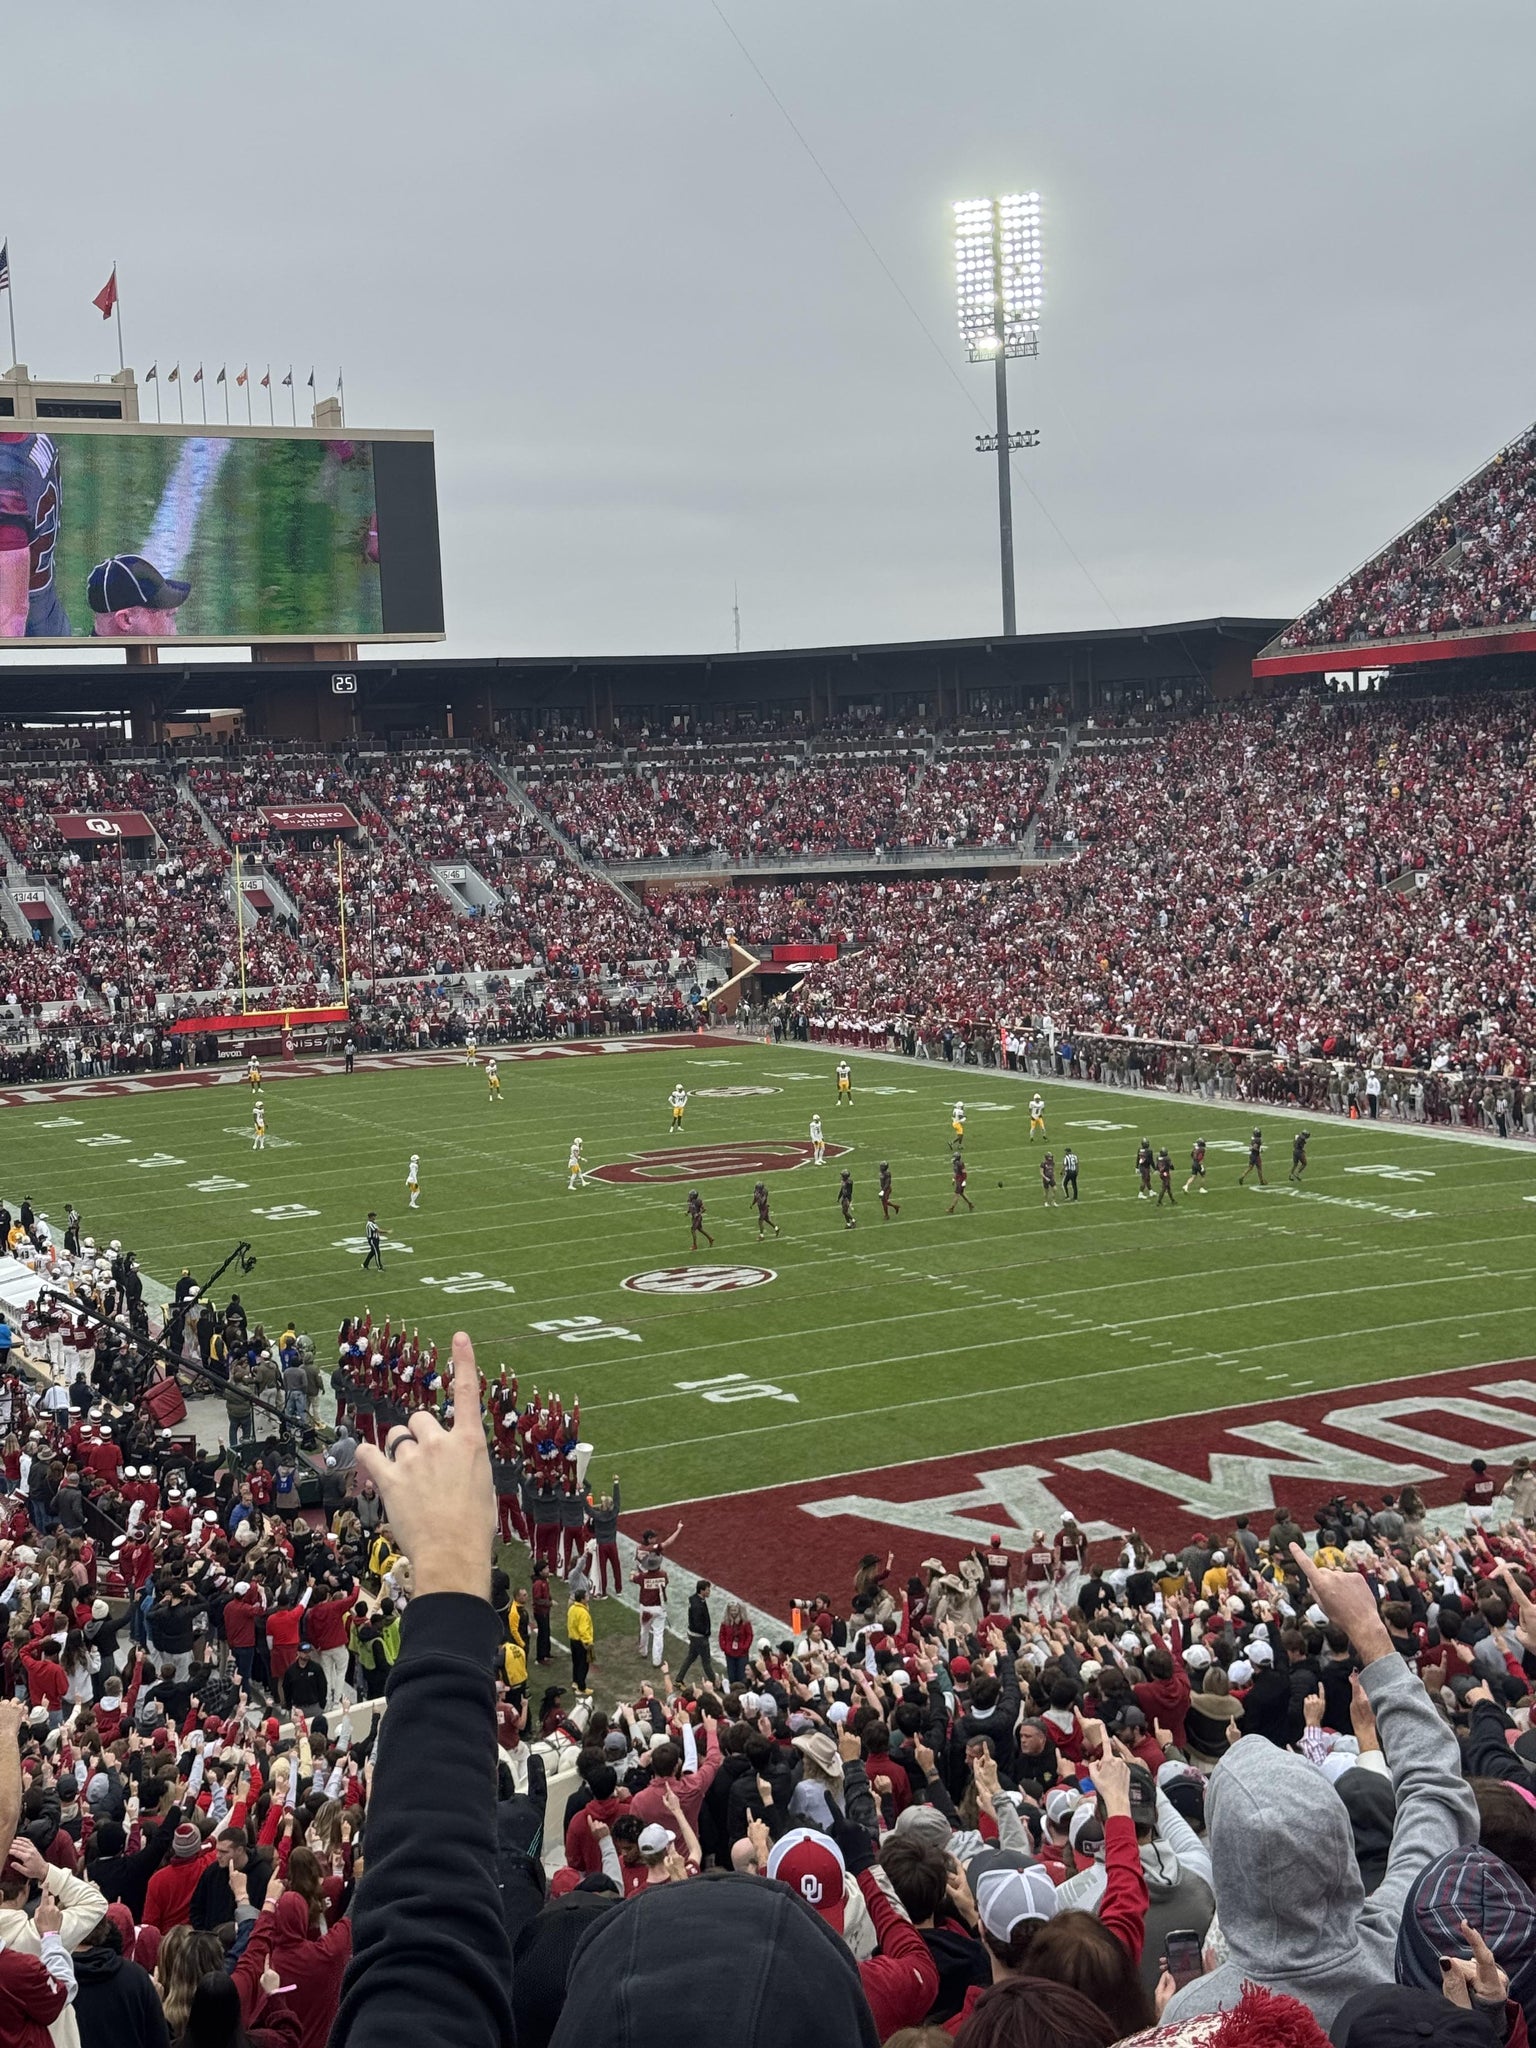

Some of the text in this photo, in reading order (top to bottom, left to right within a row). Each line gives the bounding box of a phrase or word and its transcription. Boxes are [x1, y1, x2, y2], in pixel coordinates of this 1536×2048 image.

[336, 676, 353, 690] 25
[86, 819, 122, 836] OU
[250, 1203, 322, 1216] 50
[419, 1271, 508, 1294] 30
[528, 1315, 631, 1343] 20
[672, 1373, 783, 1403] 10
[801, 1874, 823, 1904] OU
